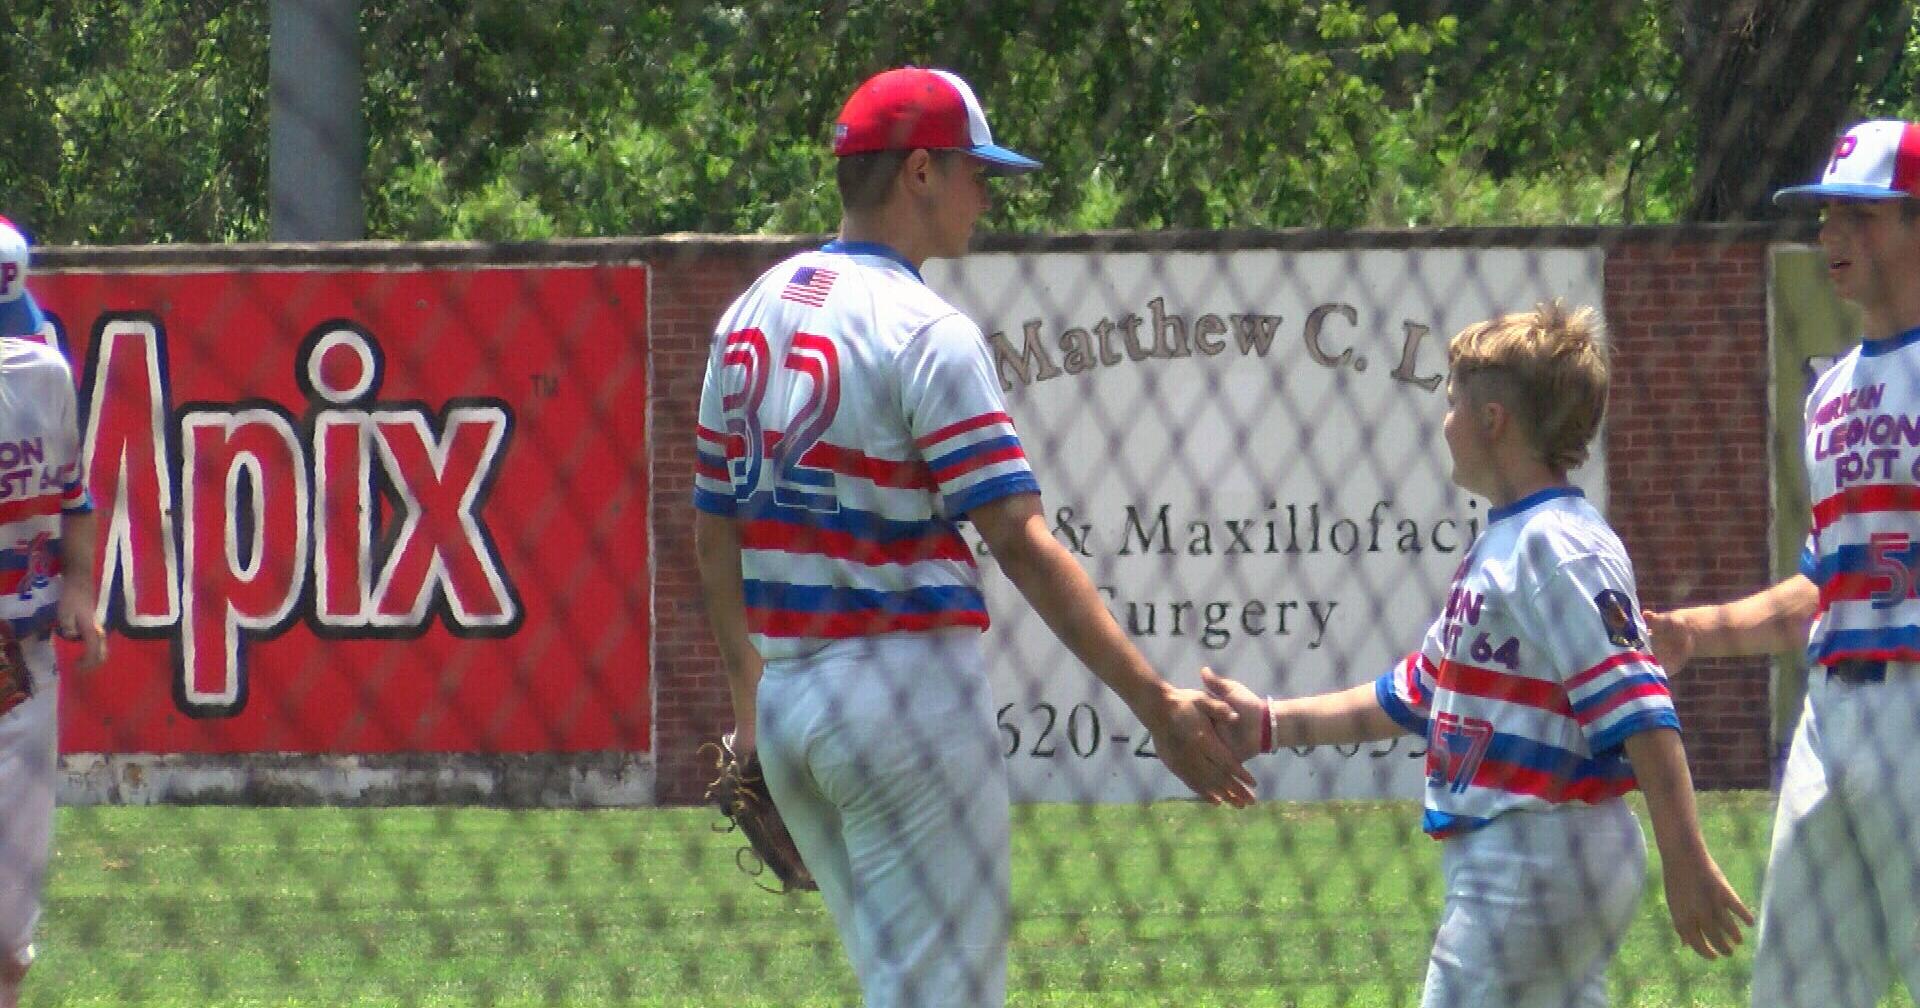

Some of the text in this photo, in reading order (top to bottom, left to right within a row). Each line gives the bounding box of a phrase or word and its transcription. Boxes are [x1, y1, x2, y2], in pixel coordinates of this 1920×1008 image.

[1829, 136, 1857, 175] P
[992, 297, 1283, 391] Matthew
[1304, 304, 1368, 374] C.
[724, 327, 843, 513] 32
[1836, 448, 1899, 487] POST
[1051, 505, 1093, 557] &
[1470, 632, 1521, 670] 64
[1427, 712, 1494, 794] 57
